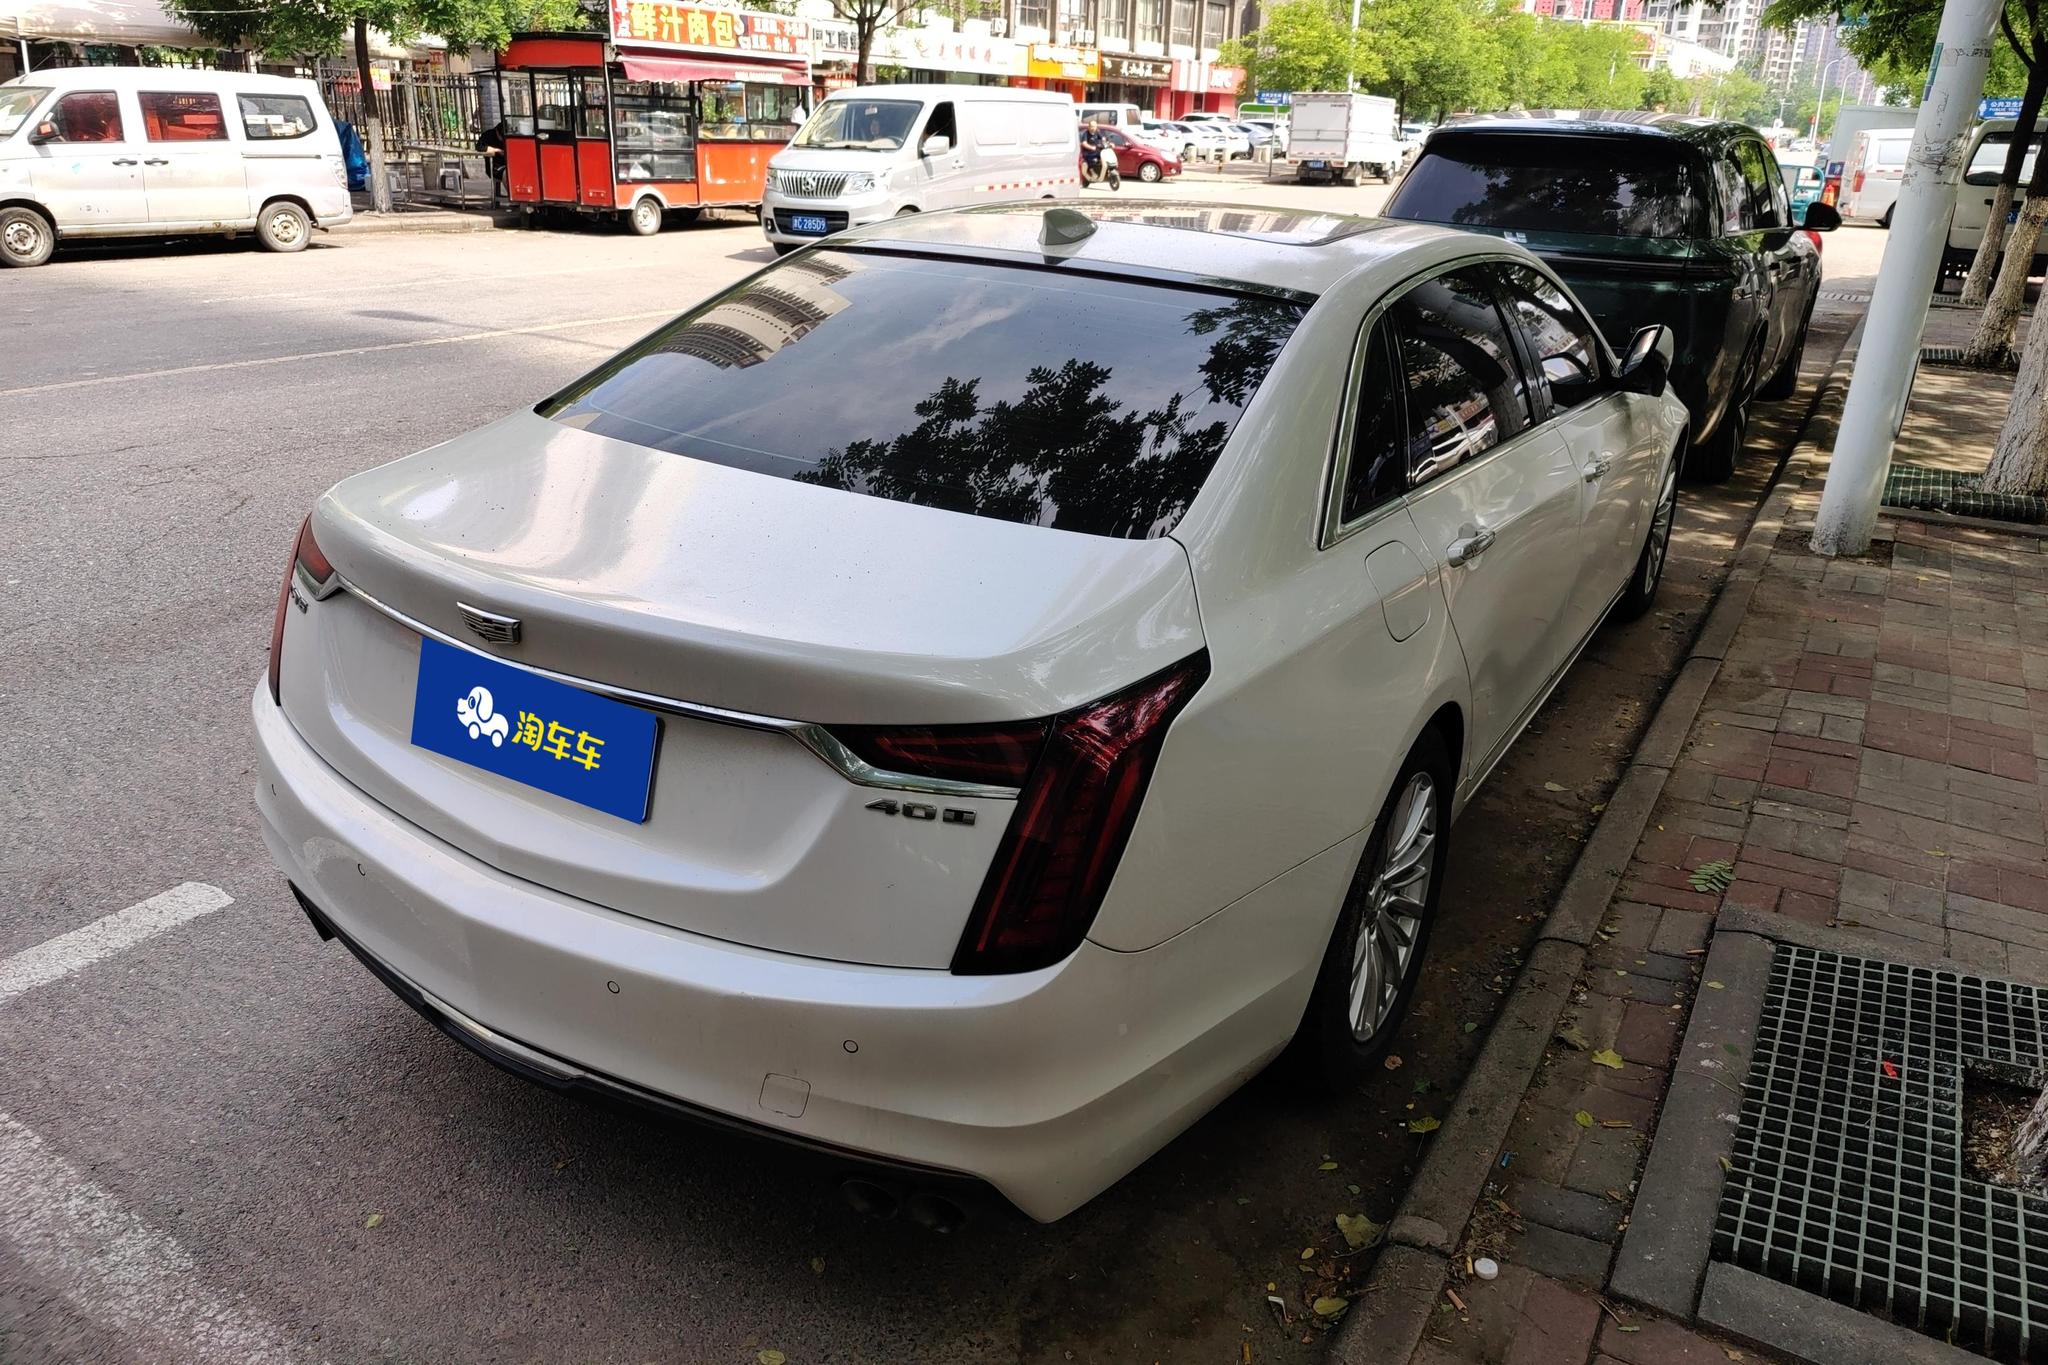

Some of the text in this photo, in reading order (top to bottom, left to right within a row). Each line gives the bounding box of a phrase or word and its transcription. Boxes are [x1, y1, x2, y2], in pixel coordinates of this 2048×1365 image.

[630, 2, 736, 48] 鲜汁肉包
[864, 798, 977, 826] 40T
